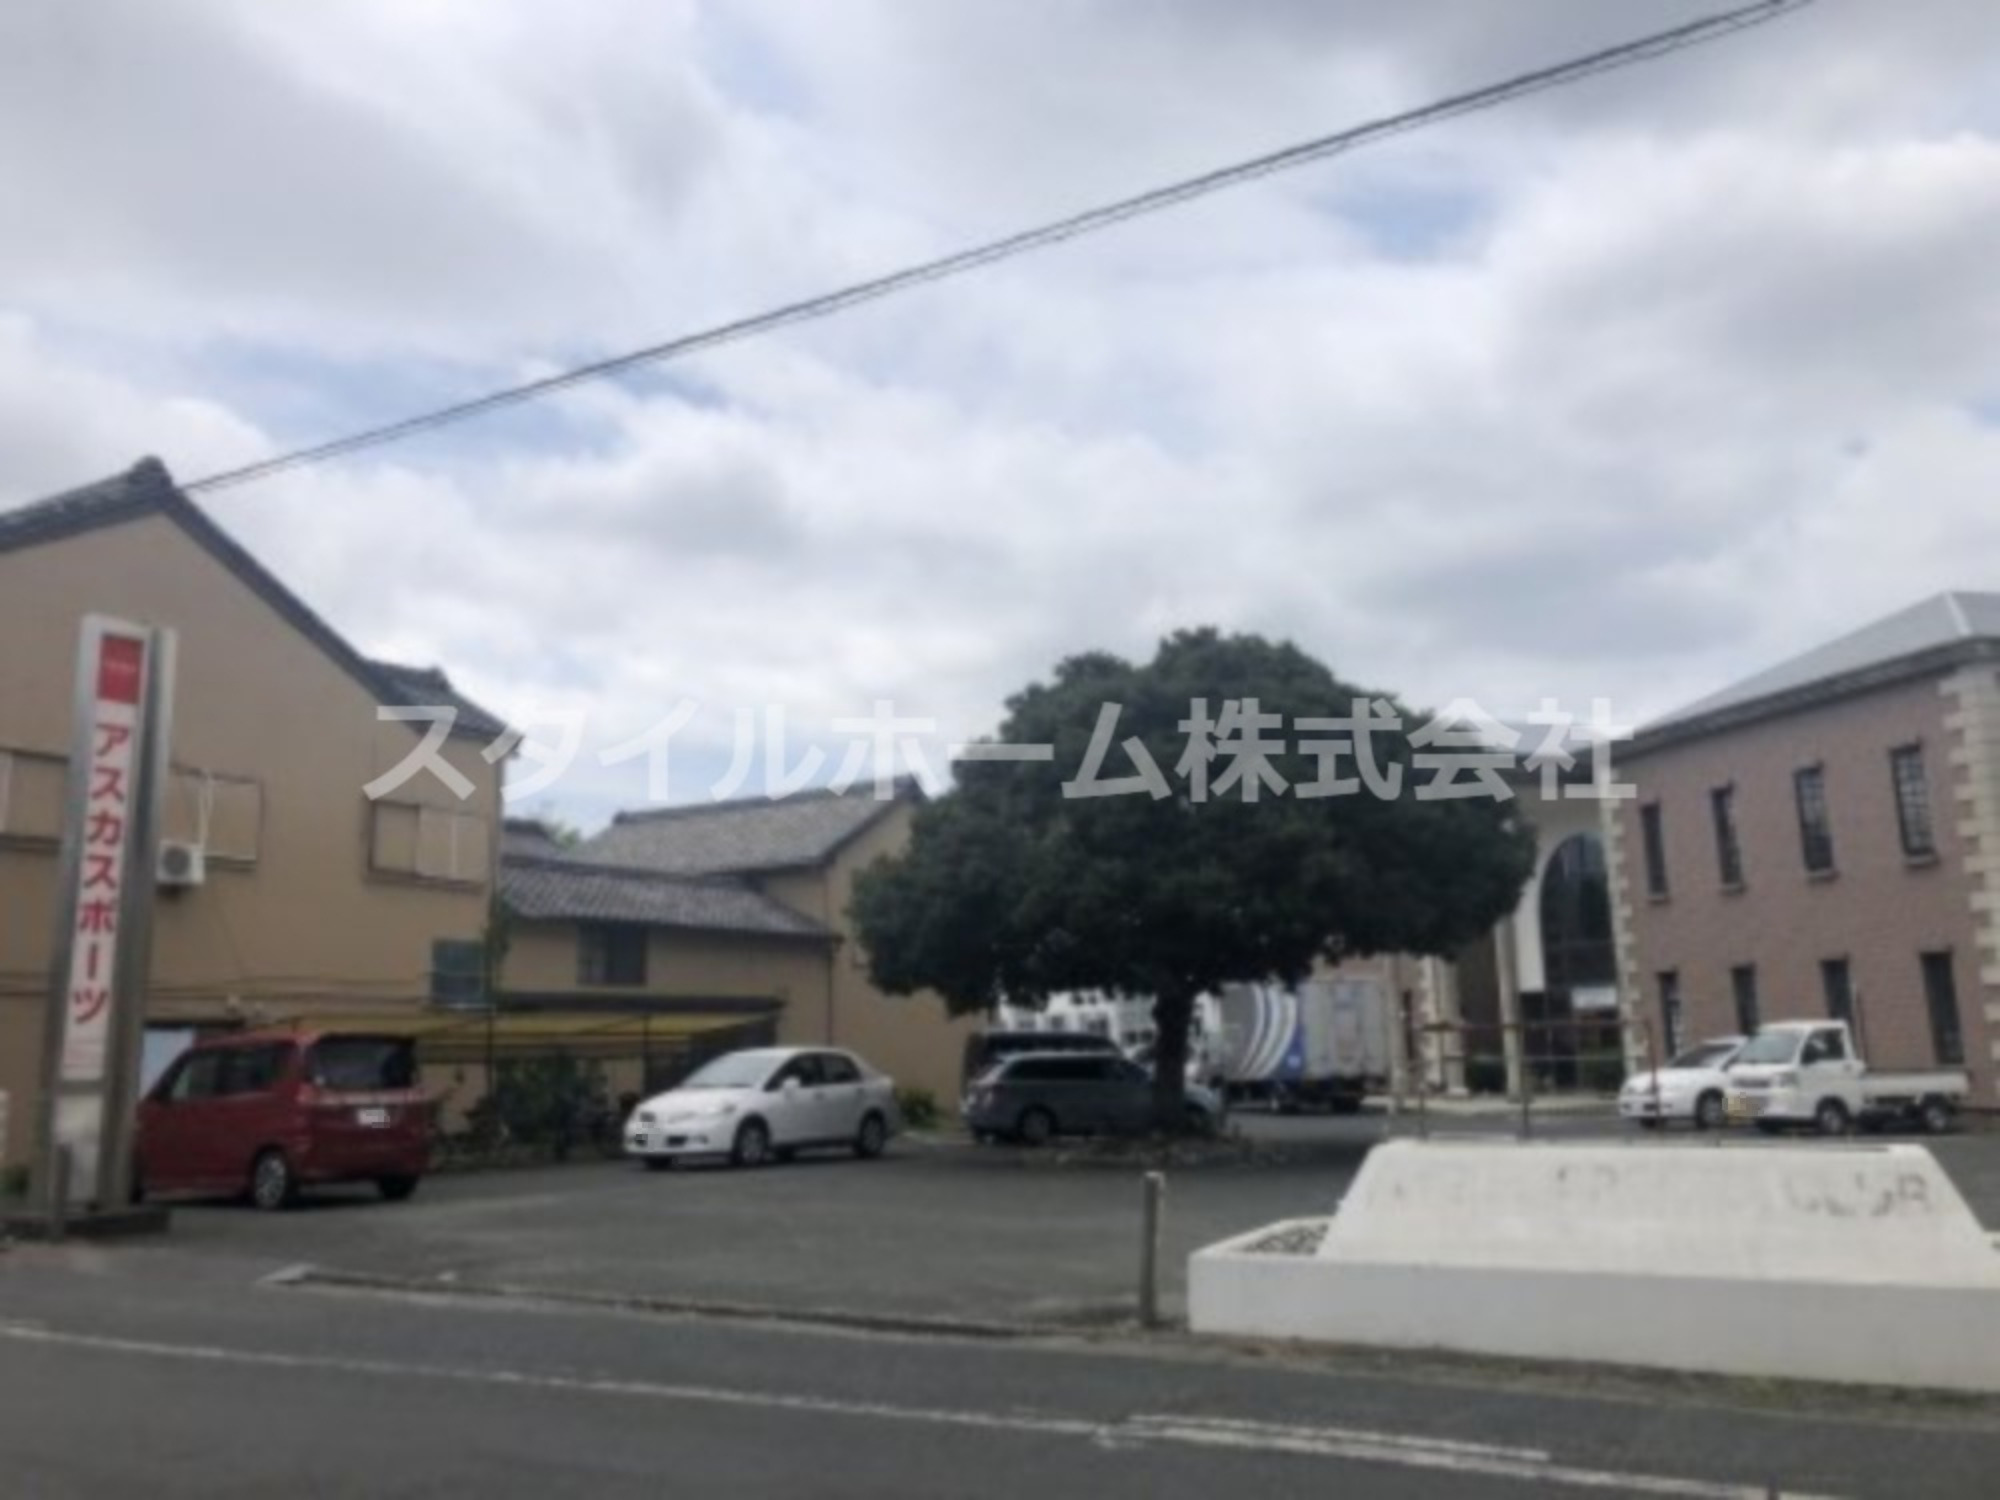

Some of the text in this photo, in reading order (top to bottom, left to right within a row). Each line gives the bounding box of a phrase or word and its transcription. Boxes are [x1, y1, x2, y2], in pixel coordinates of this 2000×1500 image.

[73, 722, 130, 1024] アスカスポーツ
